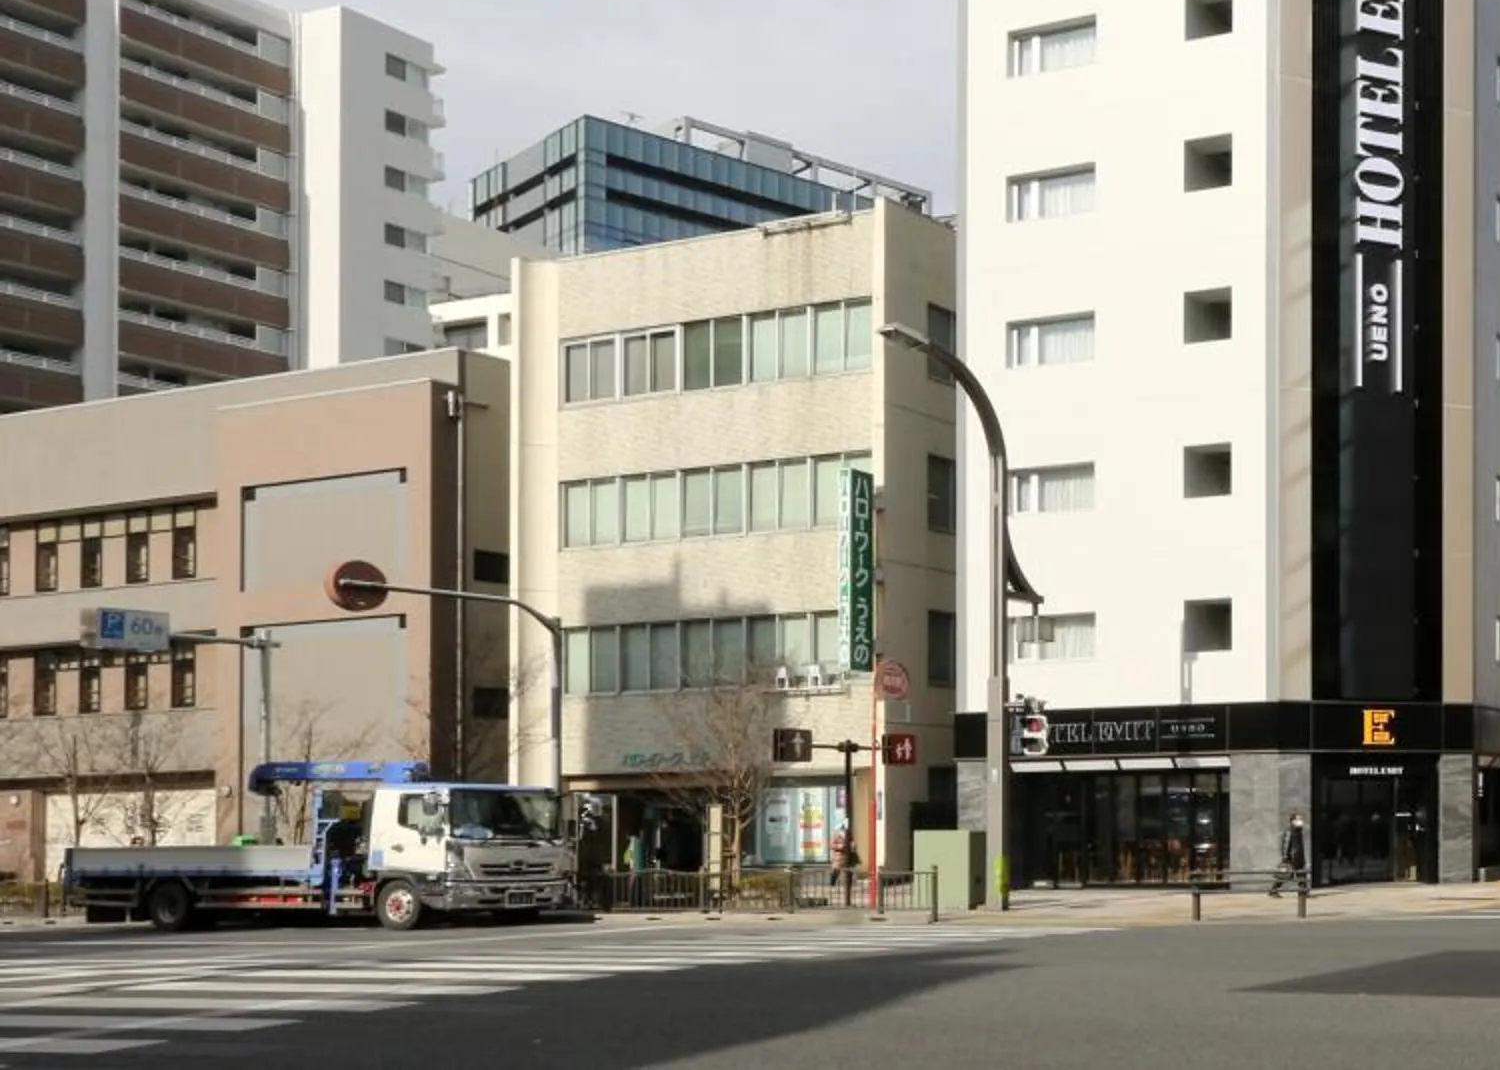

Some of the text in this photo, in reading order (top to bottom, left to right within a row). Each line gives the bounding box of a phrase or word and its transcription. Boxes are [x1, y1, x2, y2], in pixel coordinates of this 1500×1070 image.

[1355, 47, 1405, 251] HOTEL
[1369, 283, 1389, 361] UENO
[853, 477, 870, 588] ハローワーク
